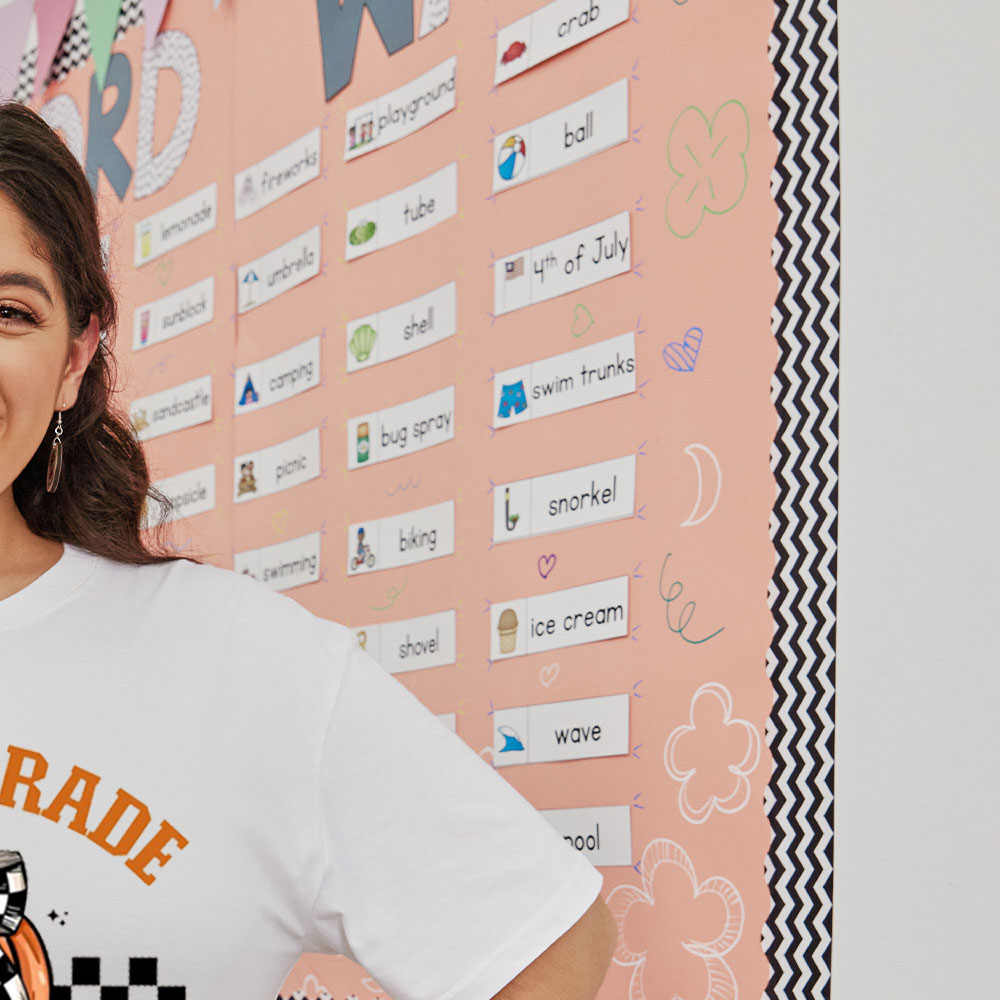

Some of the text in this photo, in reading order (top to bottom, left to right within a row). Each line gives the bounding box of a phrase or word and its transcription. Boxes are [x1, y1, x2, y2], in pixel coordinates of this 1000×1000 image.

[558, 0, 600, 38] crab
[378, 66, 456, 136] playground
[564, 111, 594, 148] ball
[261, 148, 317, 193] fireworks
[161, 202, 212, 240] lemonade
[404, 195, 436, 225] tube
[267, 247, 314, 287] umbrella
[534, 231, 628, 283] 4th of July
[404, 306, 434, 340] shell
[269, 361, 313, 391] camping
[532, 353, 635, 400] swim trunks
[381, 411, 452, 448] bug spray
[276, 456, 306, 484] picnic
[548, 475, 617, 516] snorkel
[399, 526, 437, 551] biking
[263, 554, 317, 582] swimming
[531, 604, 623, 637] ice cream
[399, 628, 439, 659] shovel
[555, 725, 602, 744] wave
